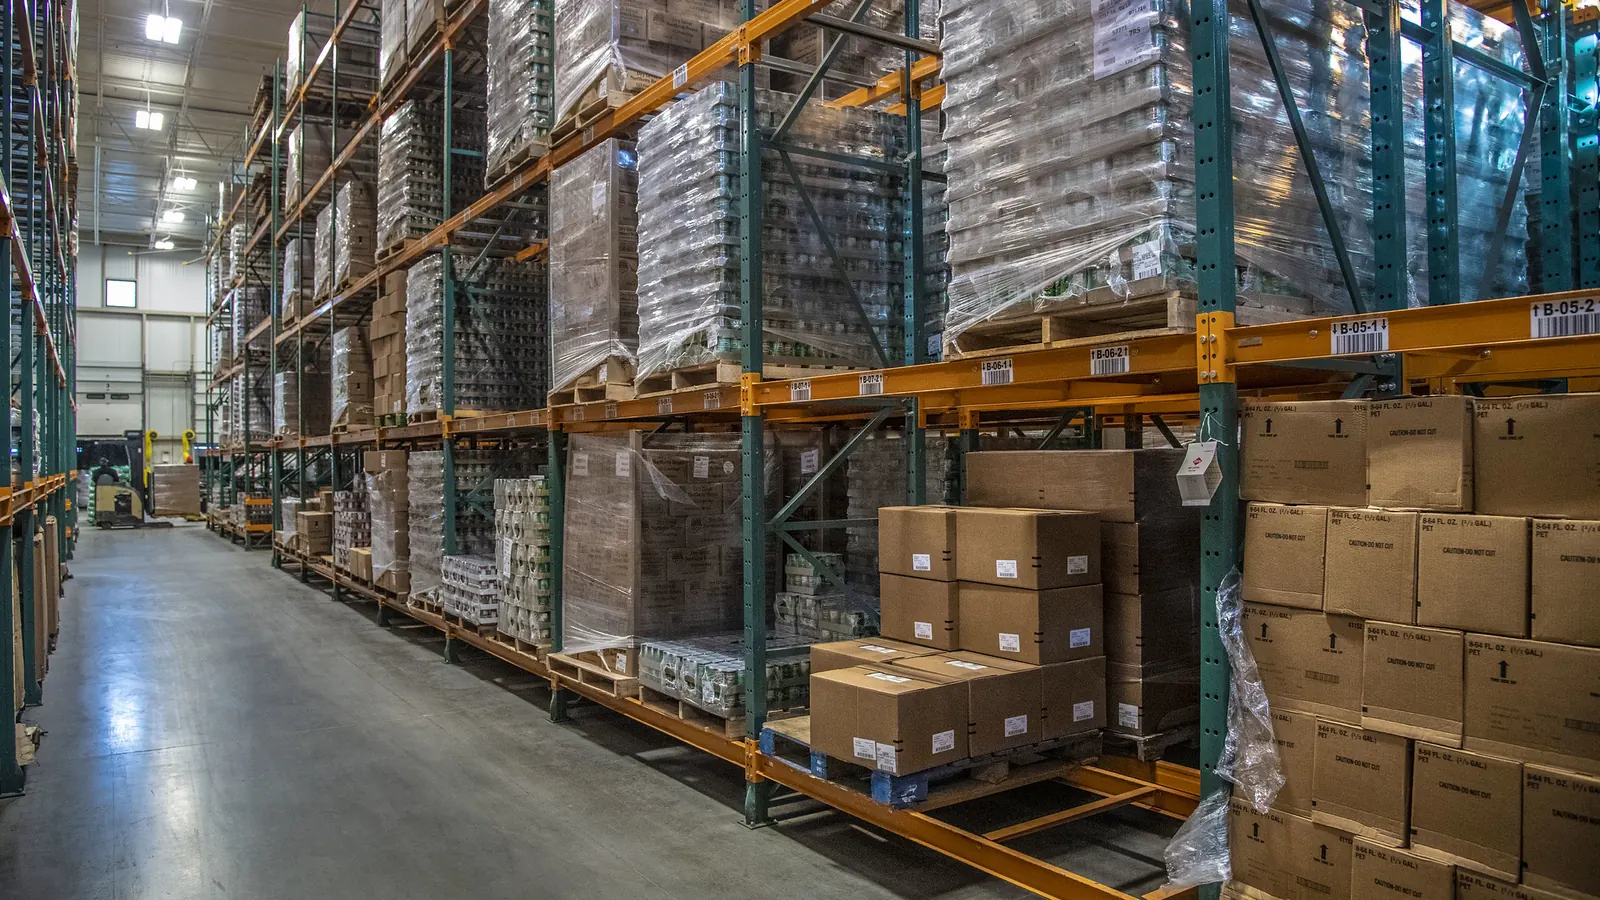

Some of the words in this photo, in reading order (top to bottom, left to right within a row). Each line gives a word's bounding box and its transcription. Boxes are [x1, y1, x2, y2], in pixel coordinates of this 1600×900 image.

[1544, 298, 1594, 316] B-05-2
[1340, 320, 1378, 334] B-05-1
[1096, 348, 1122, 359] B-06-2
[986, 360, 1008, 370] B-06-1
[1418, 756, 1429, 764] PET
[1527, 781, 1540, 790] PET
[1356, 852, 1365, 860] PET
[1460, 882, 1470, 891] PET
